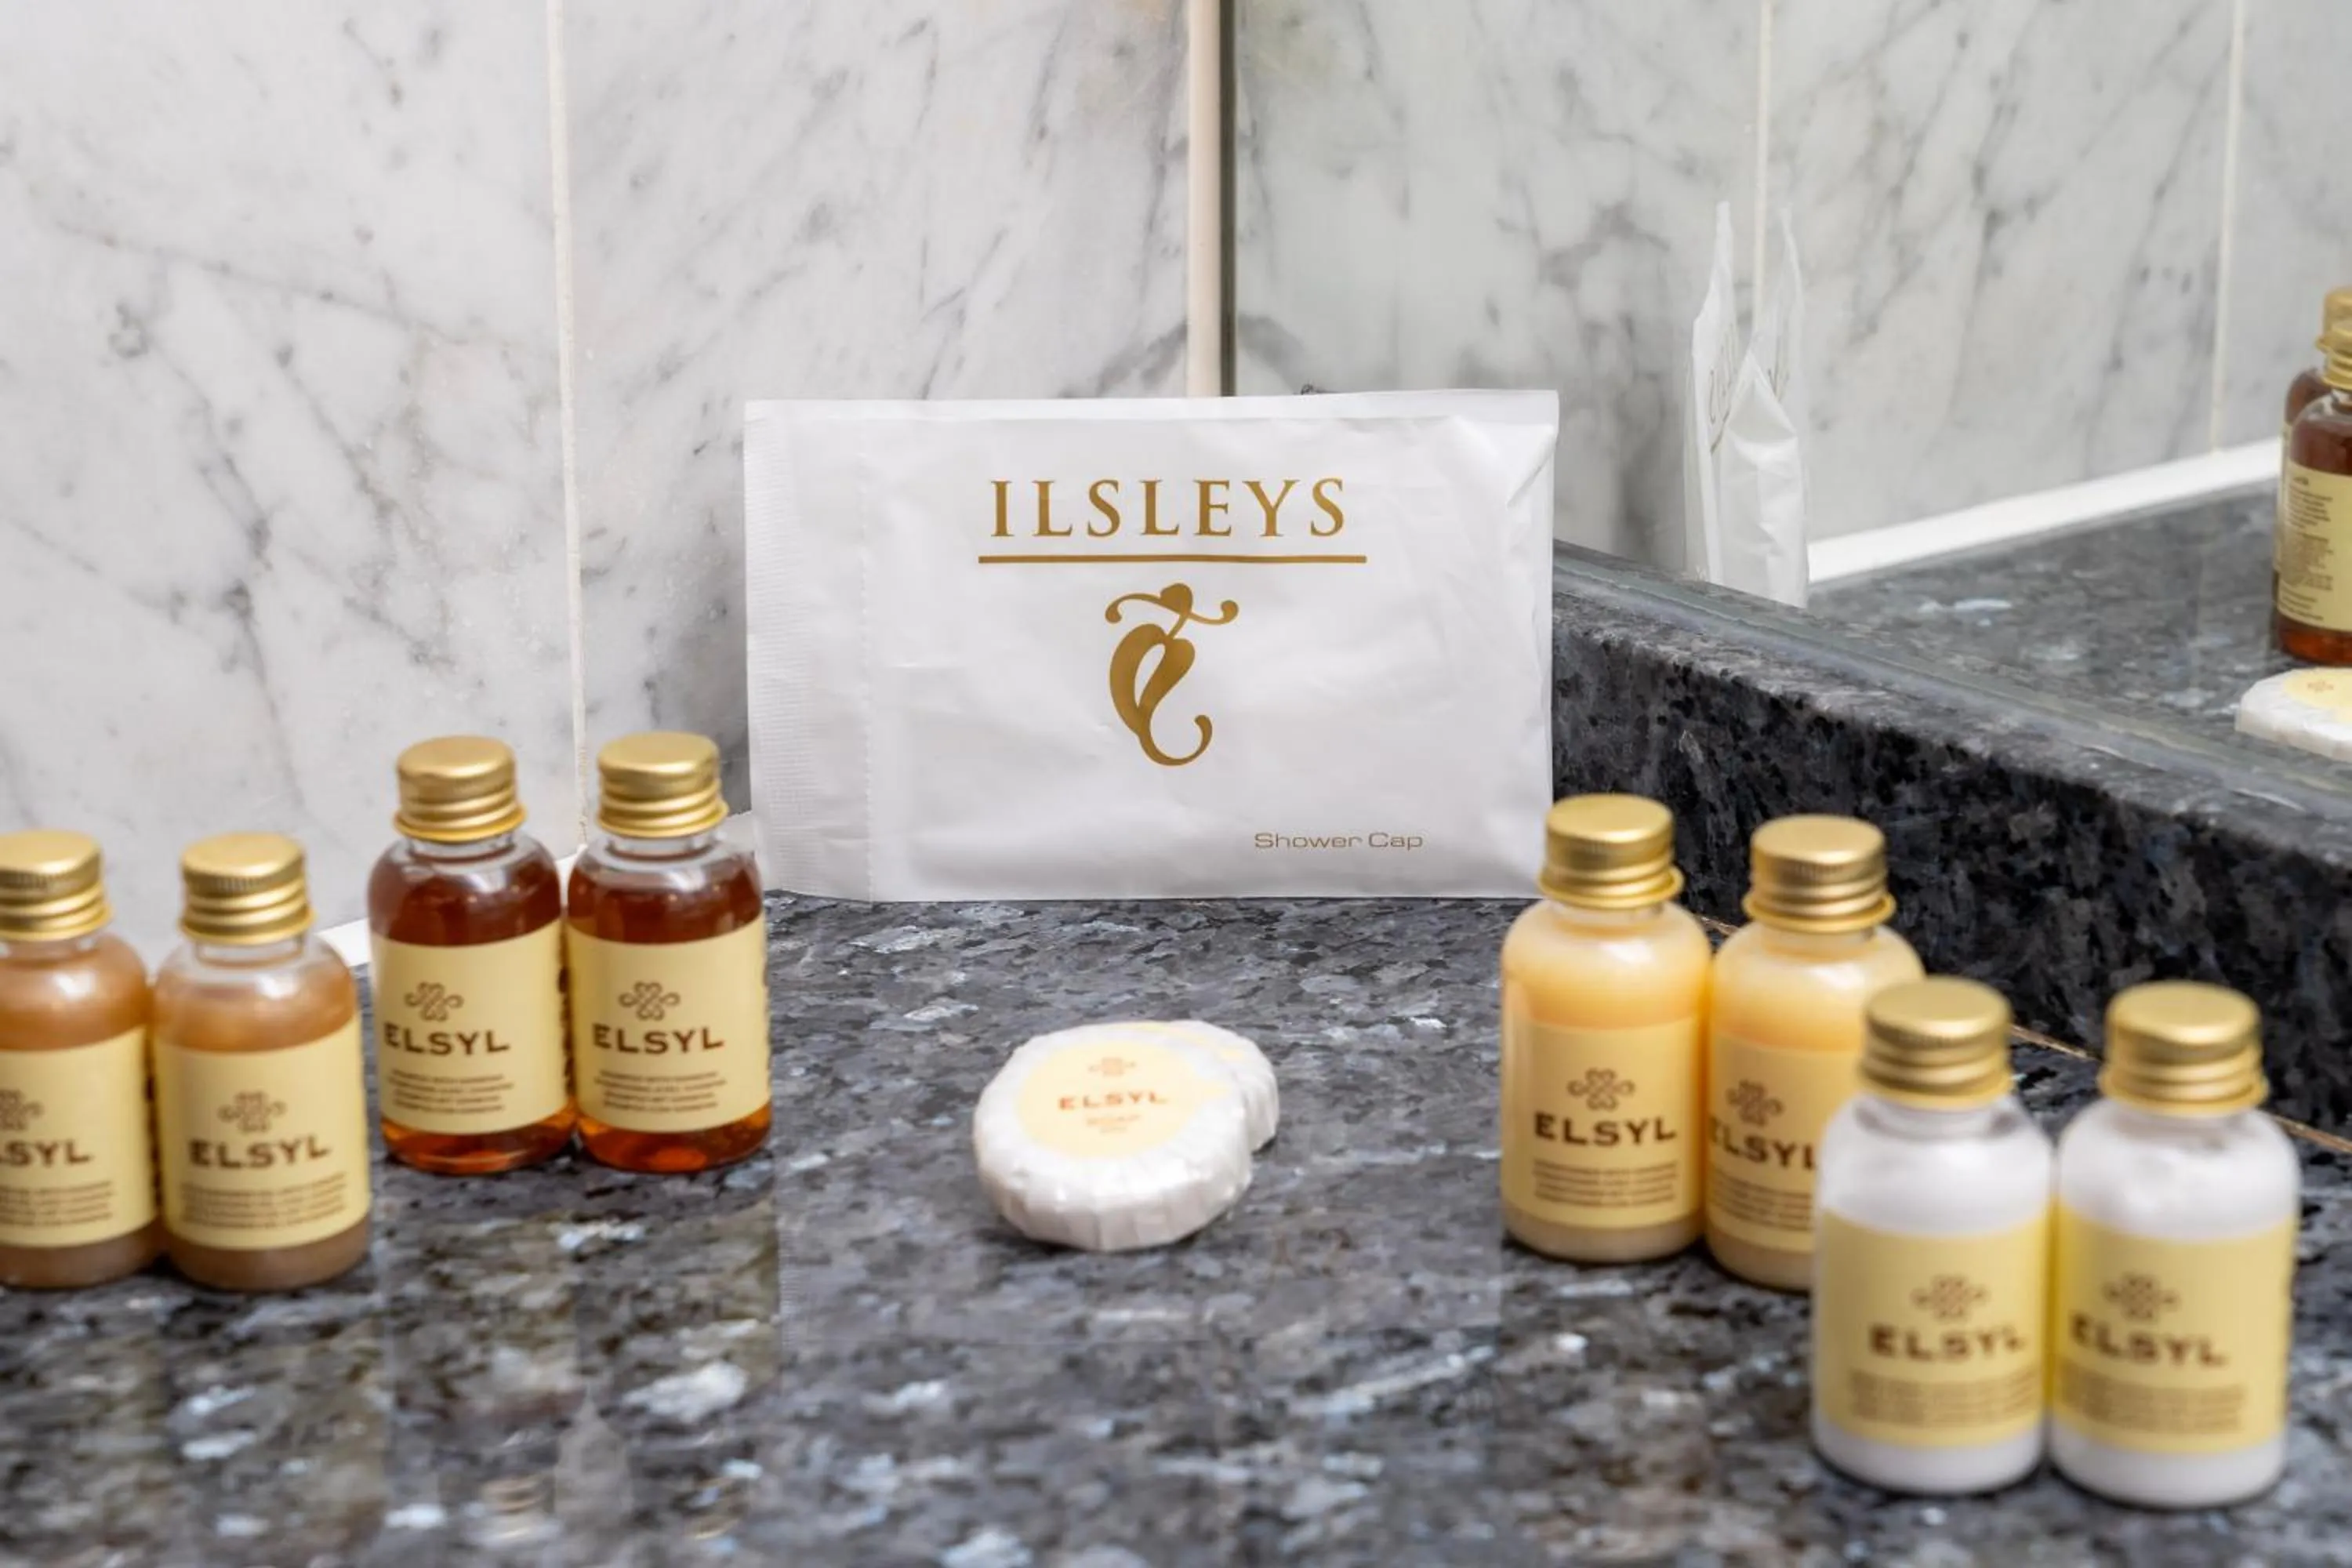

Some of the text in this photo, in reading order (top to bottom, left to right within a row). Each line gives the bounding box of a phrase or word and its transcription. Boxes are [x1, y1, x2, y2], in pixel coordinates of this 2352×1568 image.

[989, 477, 1345, 538] ILSLEYS
[1254, 832, 1424, 851] Shower Cap
[383, 1022, 511, 1056] ELSYL
[592, 1023, 725, 1055] ELSYL
[1058, 1091, 1169, 1111] ELSYL
[1534, 1112, 1677, 1147] ELSYL
[0, 1138, 93, 1169] SYL
[187, 1134, 331, 1169] ELSYL
[1868, 1322, 2026, 1361] ELSYL
[2070, 1312, 2229, 1367] ELSYL
